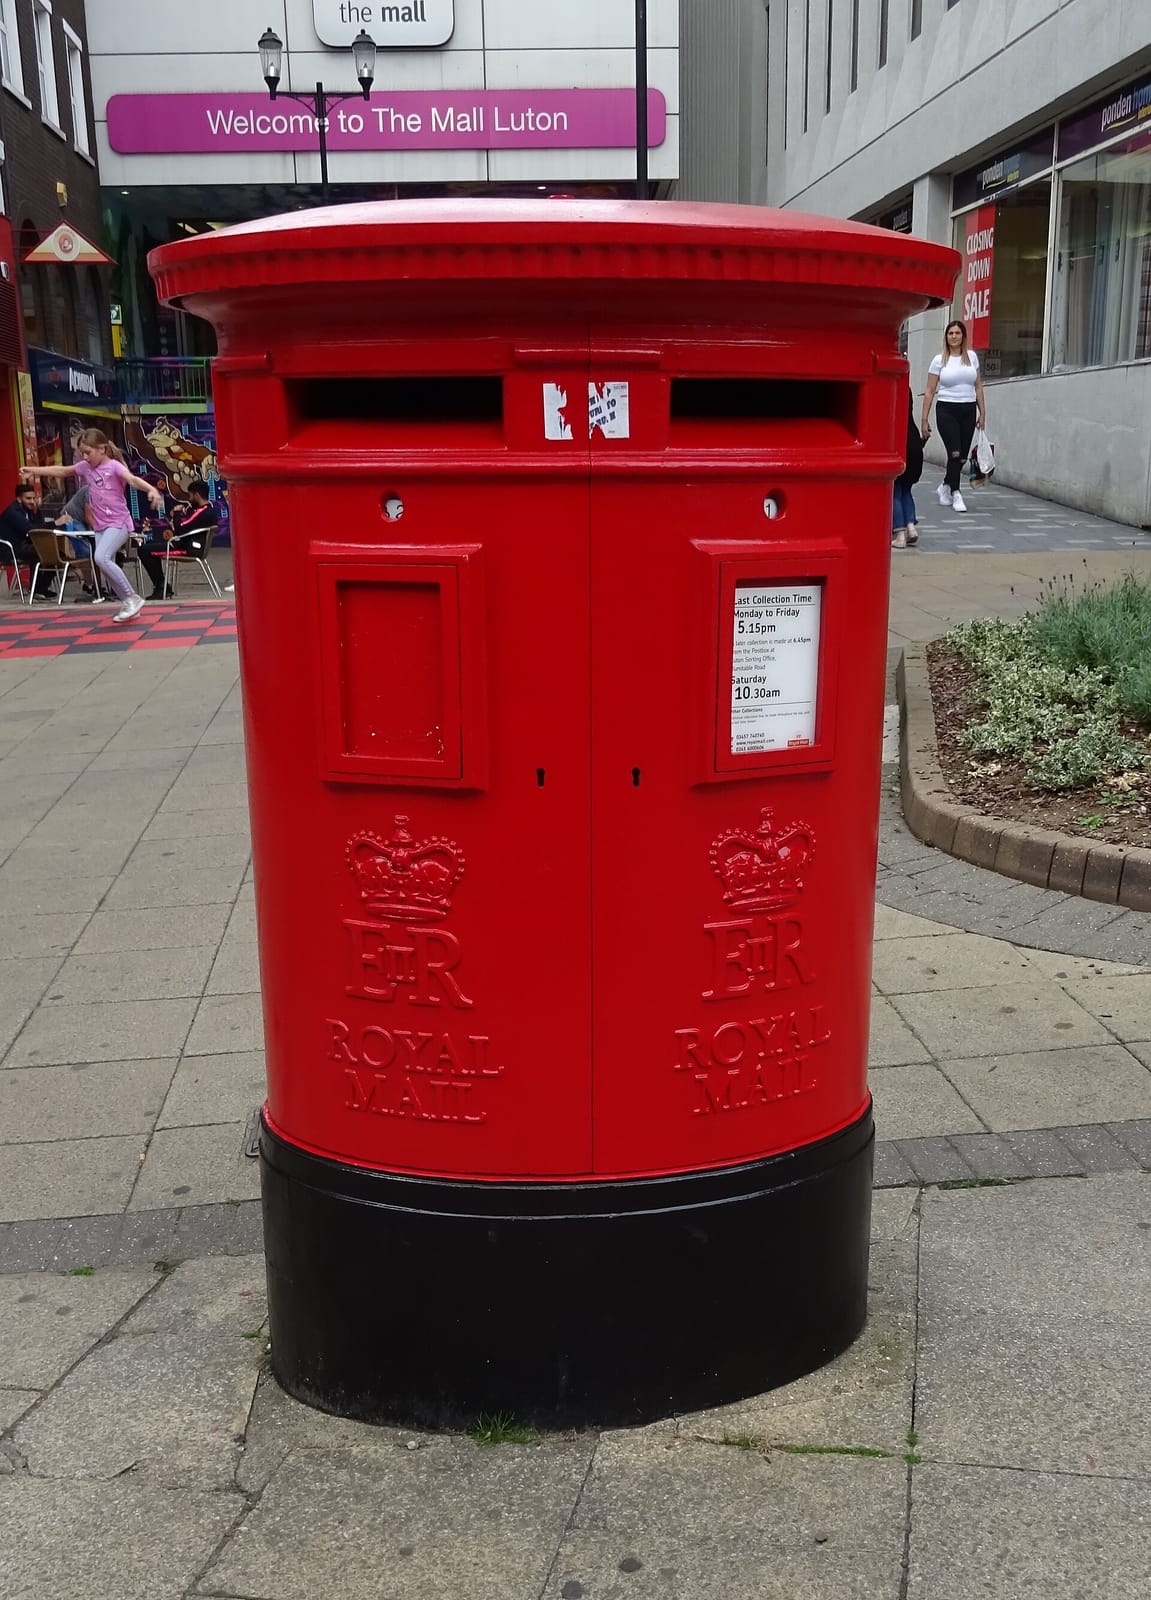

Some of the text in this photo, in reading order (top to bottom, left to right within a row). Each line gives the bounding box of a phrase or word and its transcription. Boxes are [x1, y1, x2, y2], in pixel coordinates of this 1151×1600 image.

[339, 0, 427, 23] the mall
[206, 106, 568, 135] Welcome to The Mall Luton
[1101, 93, 1132, 133] ponden
[966, 227, 994, 256] CLOSING
[967, 256, 990, 283] DOWN
[963, 288, 990, 321] SALE
[765, 503, 771, 518] 1
[752, 594, 791, 605] Collection
[792, 593, 812, 603] Time
[765, 609, 774, 617] to
[775, 607, 800, 618] Friday
[737, 620, 776, 636] 5.15pm
[732, 674, 767, 686] Saturday
[734, 685, 781, 700] 10.30am
[325, 1016, 506, 1078] ROYAL
[673, 1005, 833, 1072] ROYAL
[344, 1067, 488, 1125] MAIL
[692, 1053, 819, 1116] MAIL
